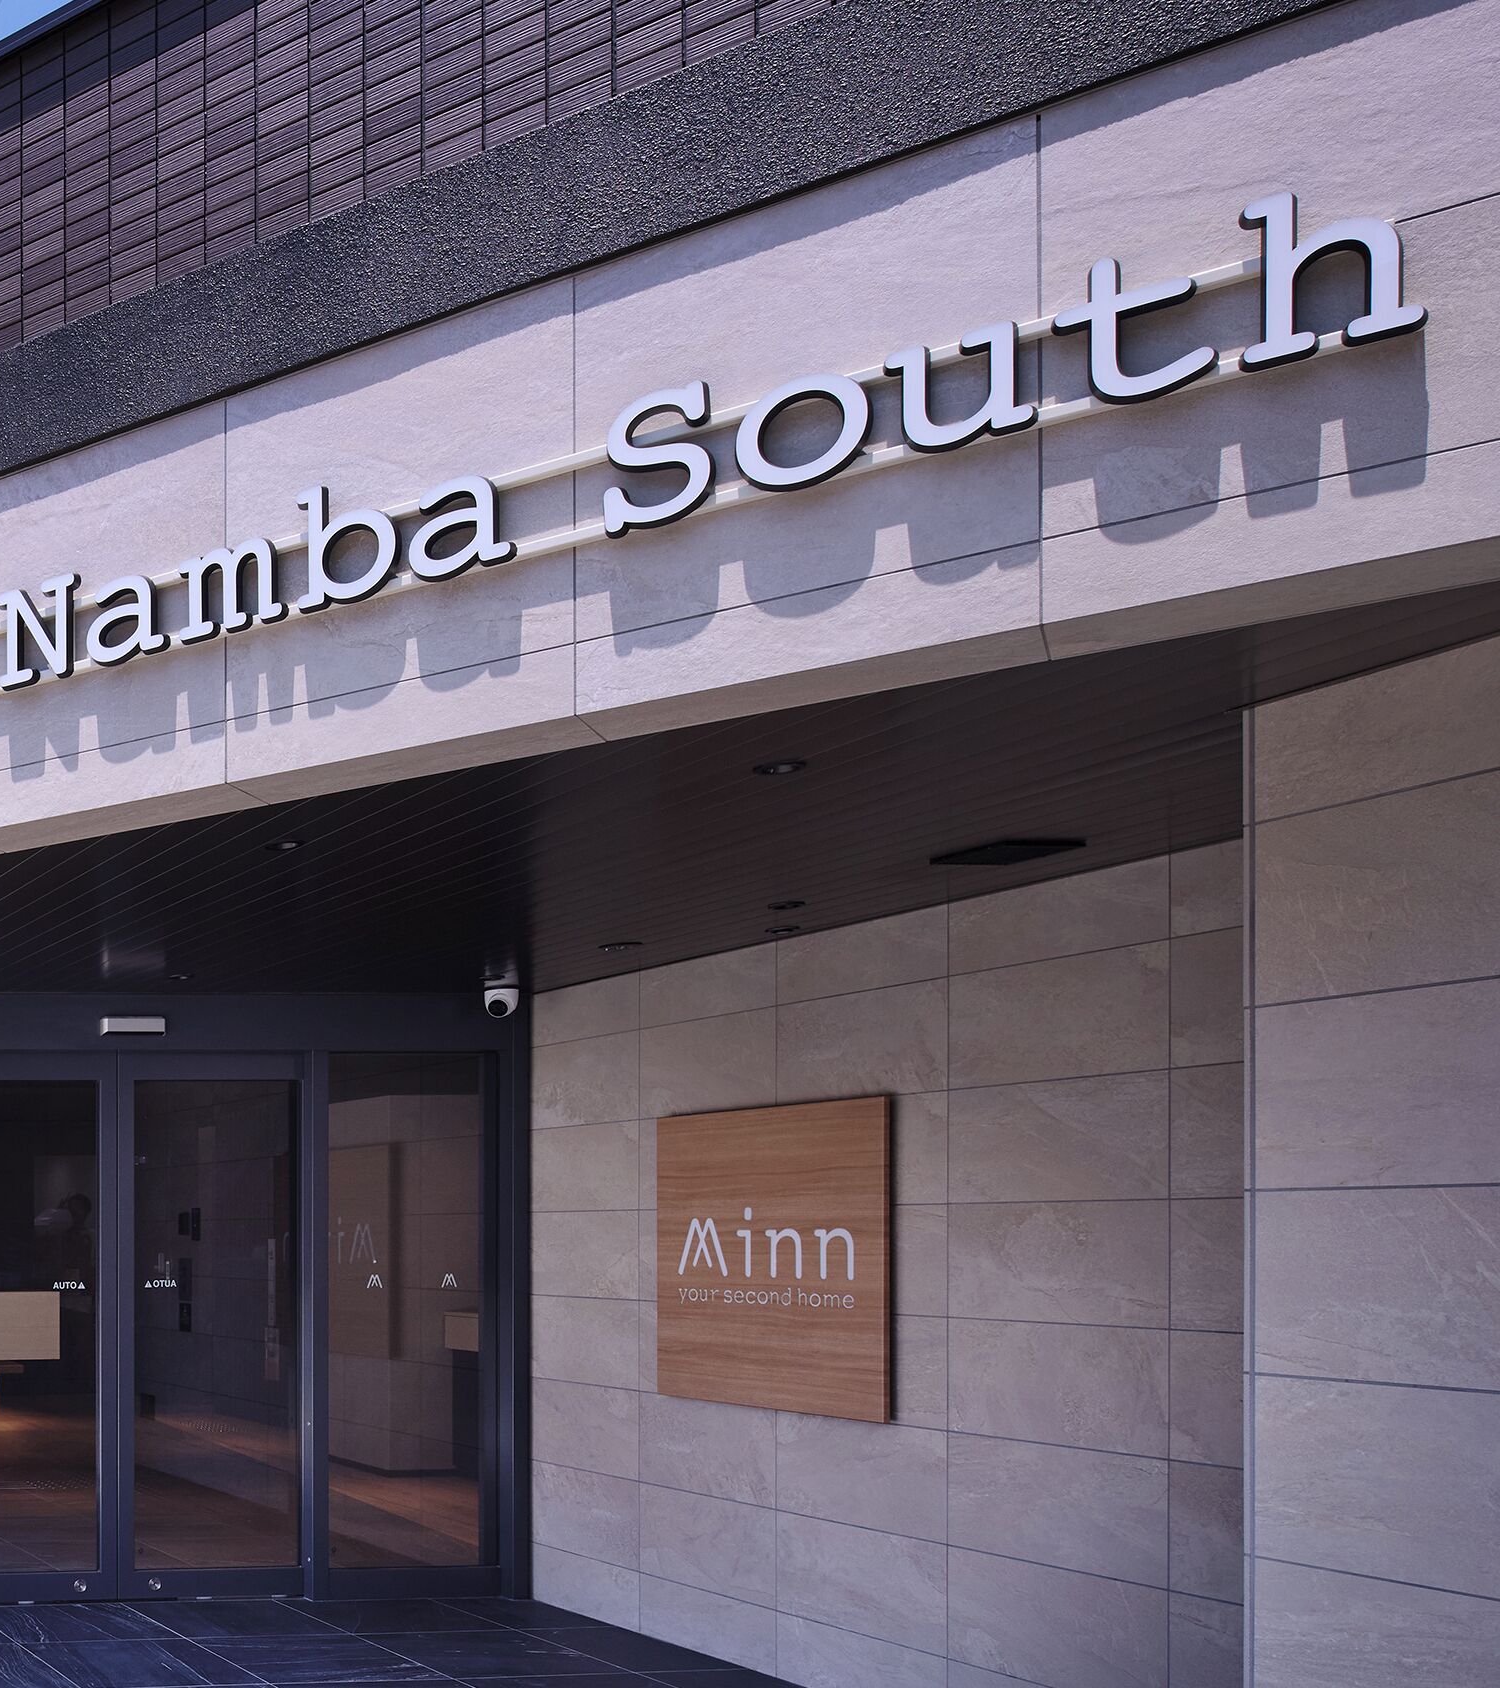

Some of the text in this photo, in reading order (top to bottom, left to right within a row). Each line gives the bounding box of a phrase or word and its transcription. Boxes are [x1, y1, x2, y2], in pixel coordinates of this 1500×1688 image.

[602, 191, 1429, 538] South
[678, 1206, 855, 1281] Minn
[52, 1281, 77, 1289] AUTO
[678, 1287, 855, 1309] your second home
